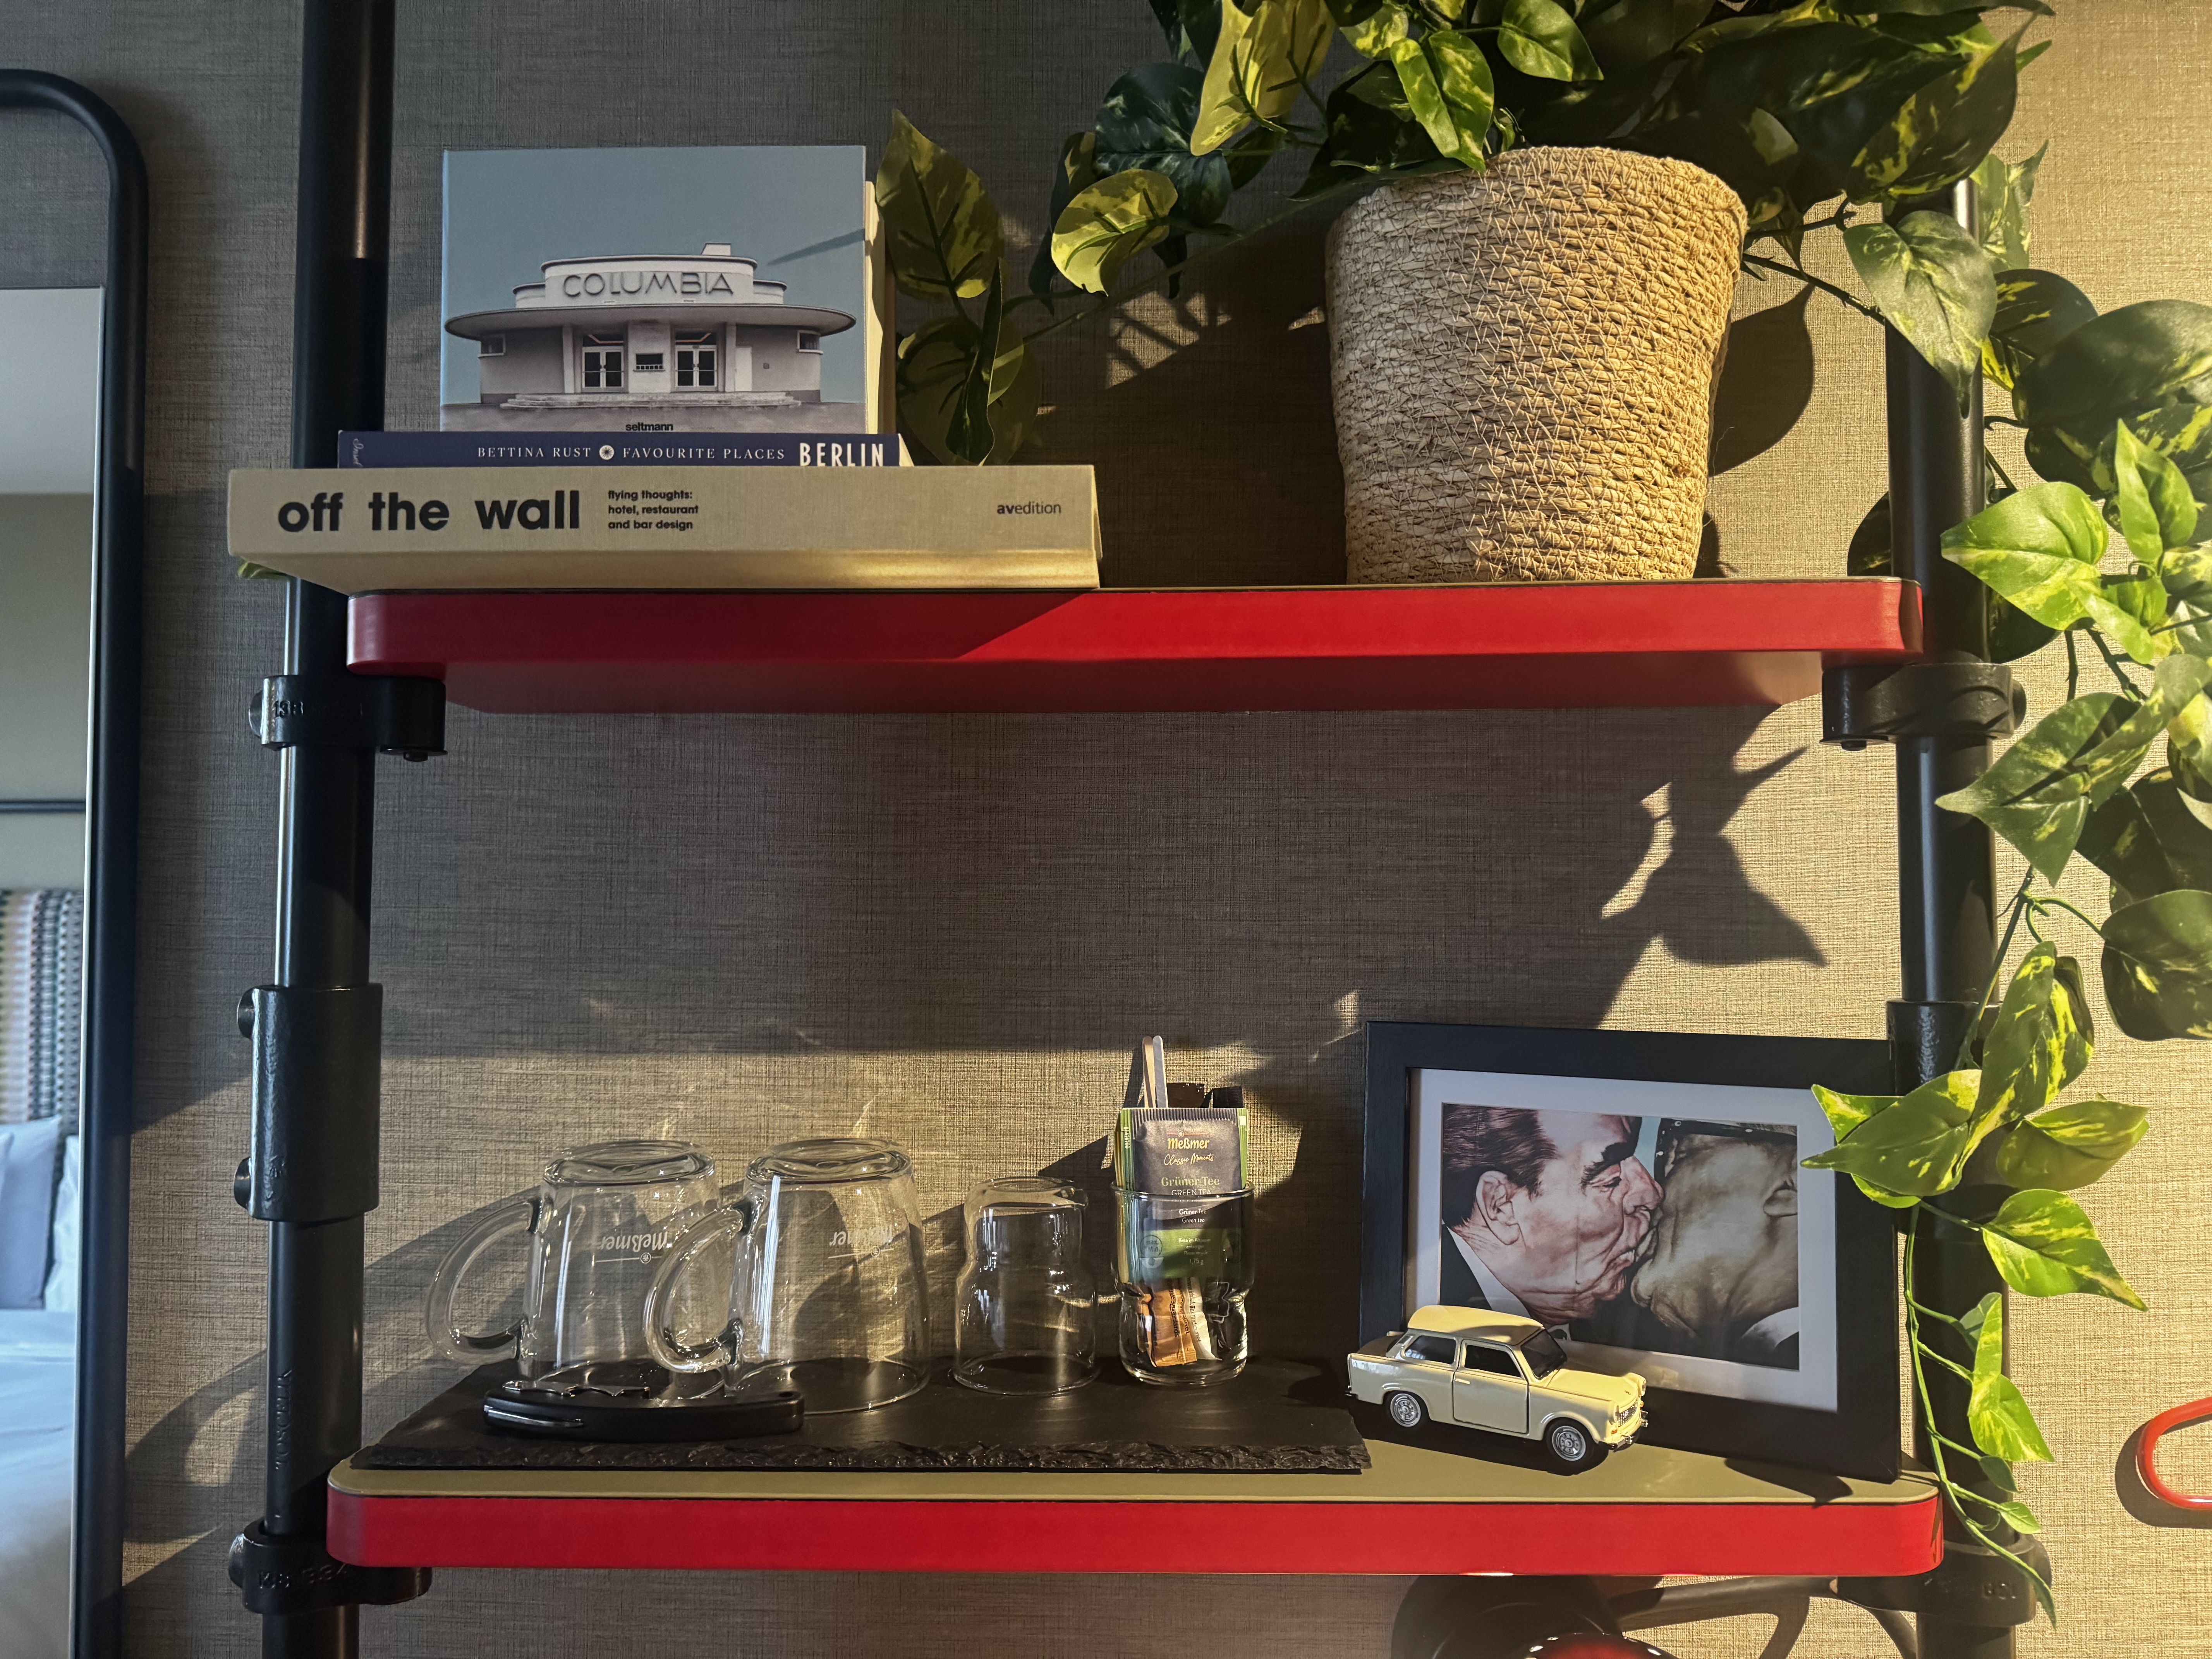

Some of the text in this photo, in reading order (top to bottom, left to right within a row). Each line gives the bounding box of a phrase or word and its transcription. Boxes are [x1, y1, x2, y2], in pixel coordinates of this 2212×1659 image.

[563, 271, 733, 297] COLUMBIA
[625, 422, 673, 431] seltmann
[478, 447, 591, 457] BETTINA RUST
[623, 443, 883, 467] FAVOURITE PLACES BERLIN
[608, 490, 692, 501] flying thoughts:
[278, 490, 579, 532] off the wall
[608, 505, 699, 515] hotel, restaurant
[997, 501, 1061, 514] avedition
[608, 520, 693, 531] and bar design
[1167, 1137, 1210, 1149] Meßmer
[1164, 1152, 1214, 1166] Classic Moments
[1161, 1176, 1219, 1186] Grüner Tee
[598, 1231, 668, 1252] Meßmer
